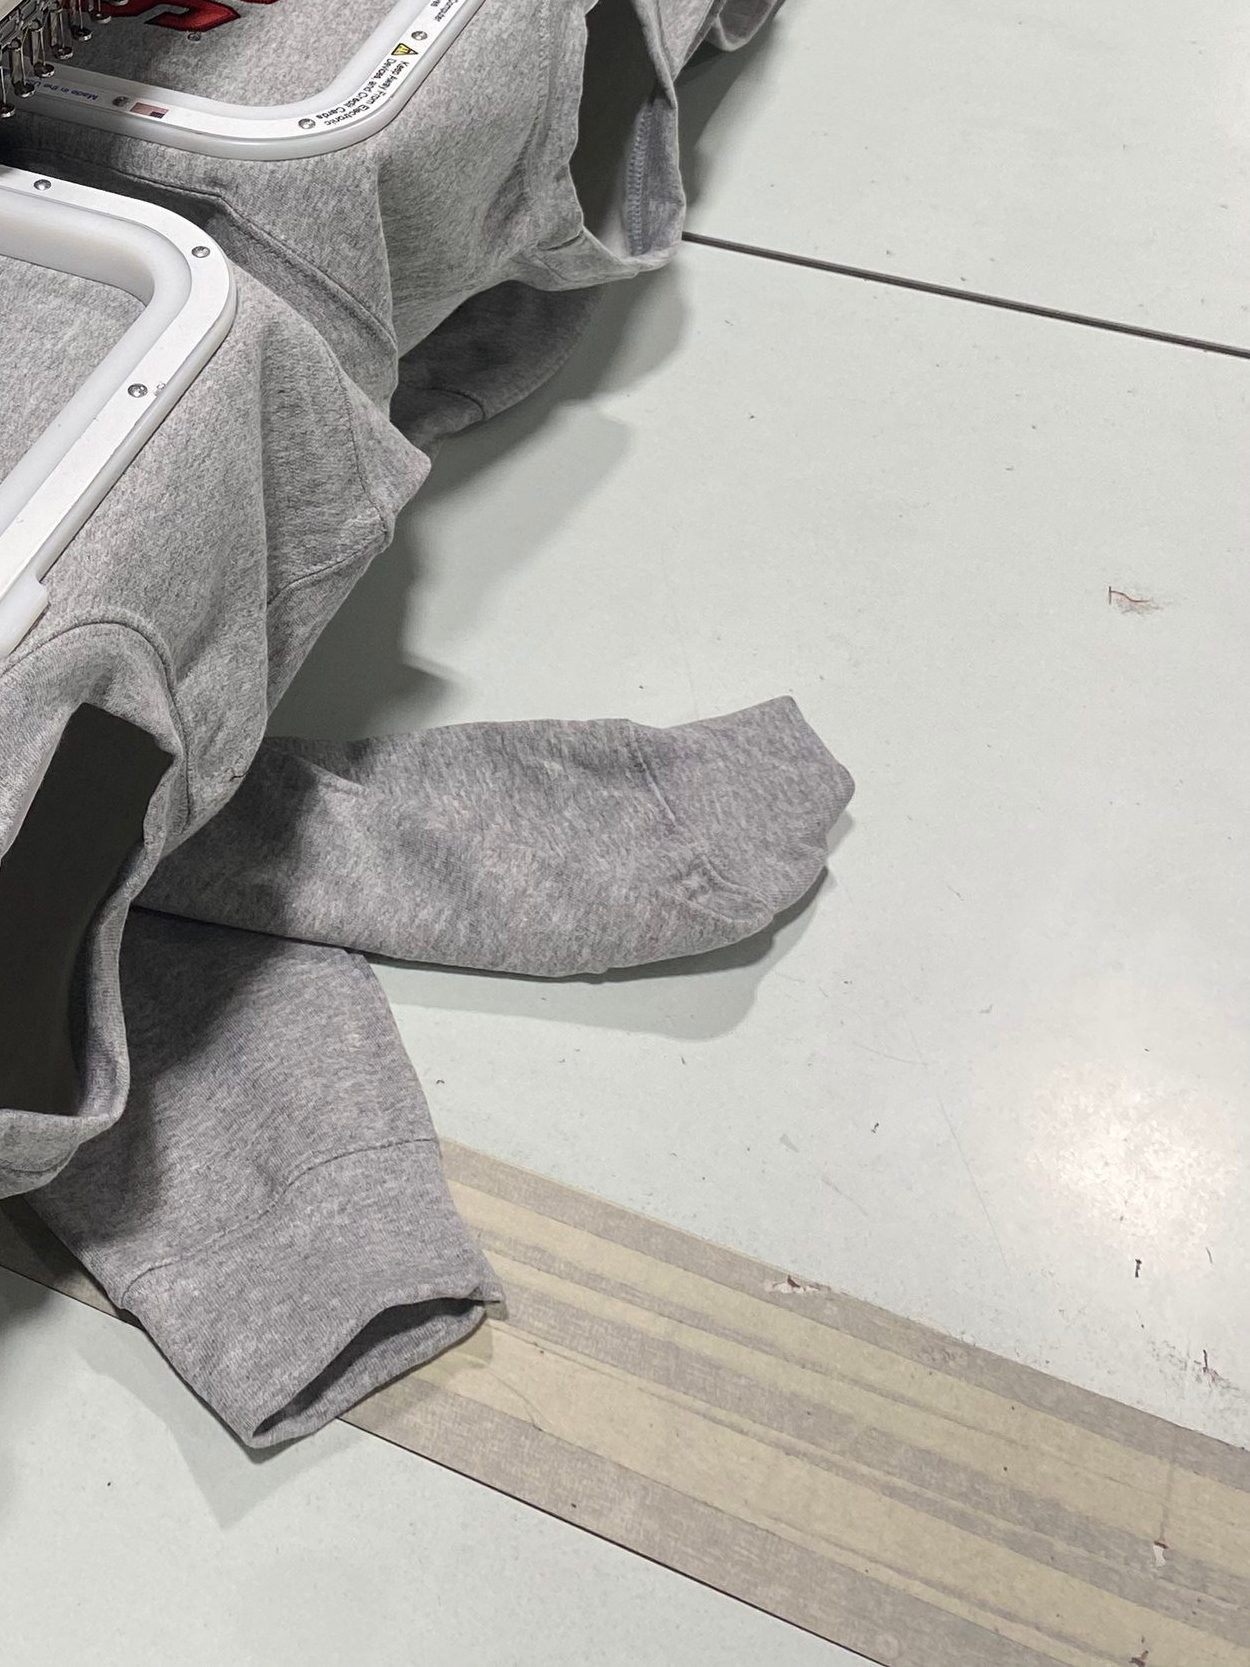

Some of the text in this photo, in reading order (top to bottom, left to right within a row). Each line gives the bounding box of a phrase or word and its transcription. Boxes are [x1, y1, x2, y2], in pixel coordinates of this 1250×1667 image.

[434, 0, 458, 22] Computer
[71, 89, 99, 101] Made
[324, 61, 410, 126] Keep Away From Electronic
[316, 106, 346, 119] Cards
